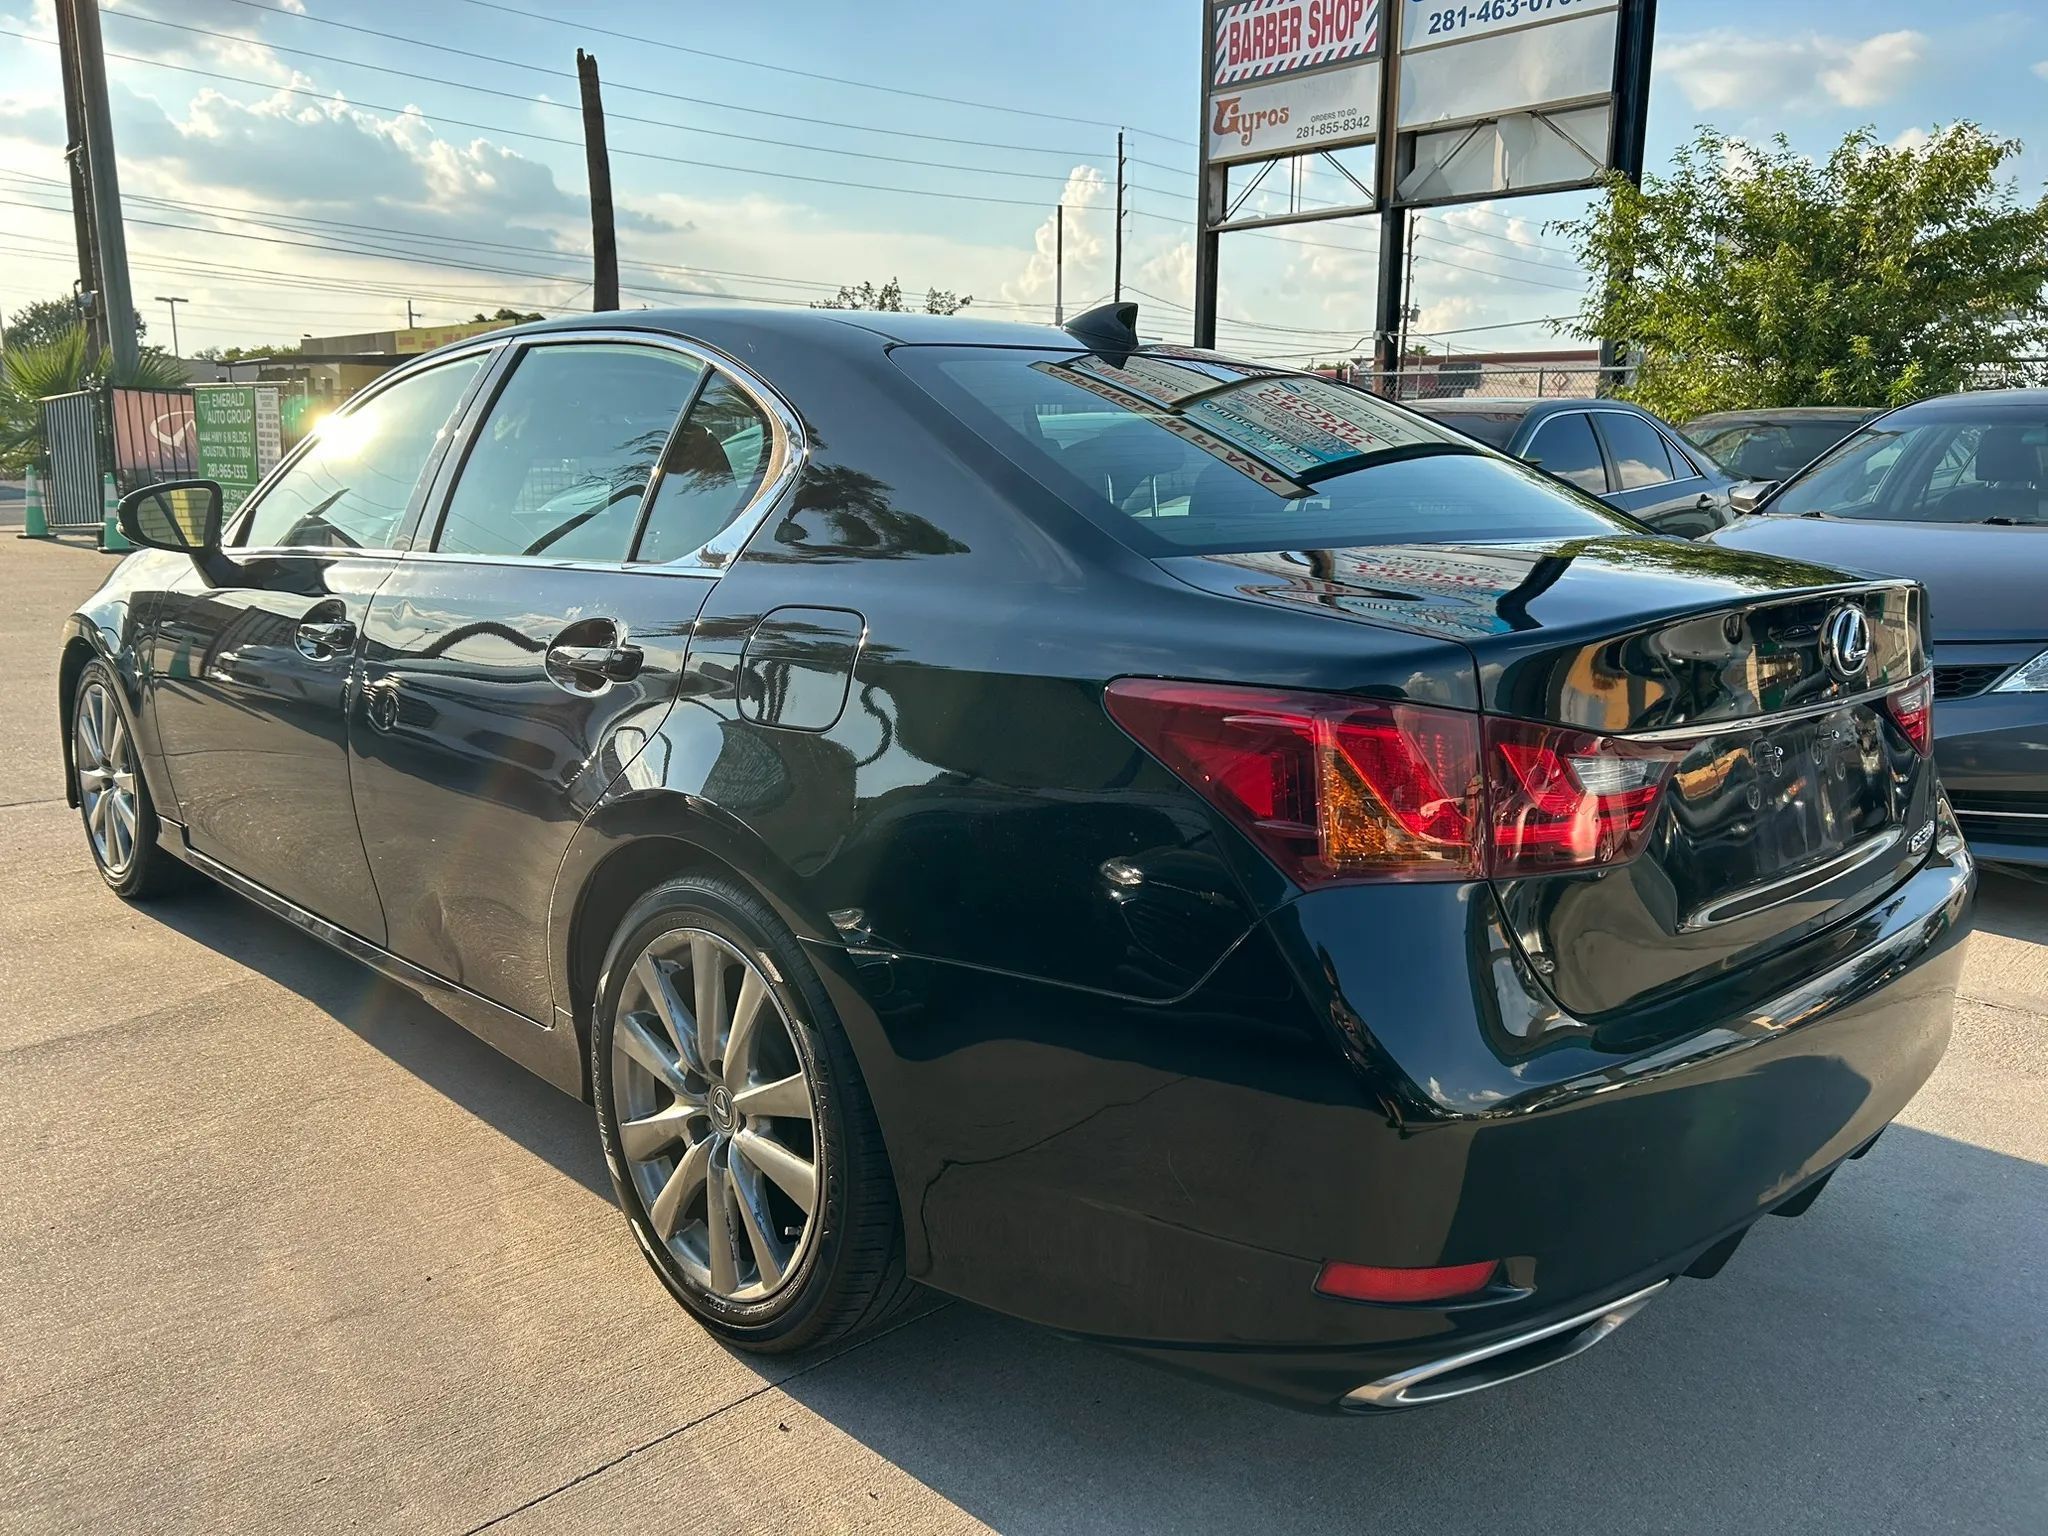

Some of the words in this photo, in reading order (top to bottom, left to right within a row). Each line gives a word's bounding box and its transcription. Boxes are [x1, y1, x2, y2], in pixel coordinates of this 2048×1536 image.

[1229, 6, 1302, 66] BARBER
[1308, 0, 1364, 49] SHOP
[1213, 97, 1290, 146] Gyros
[1311, 111, 1336, 123] ORDERS
[1337, 109, 1346, 119] TO
[1347, 107, 1357, 117] GO
[1296, 115, 1370, 139] 281-855-8342
[212, 392, 245, 407] EMERALD
[207, 411, 226, 424] AUTO
[227, 410, 251, 423] GROUP
[228, 446, 236, 458] TX
